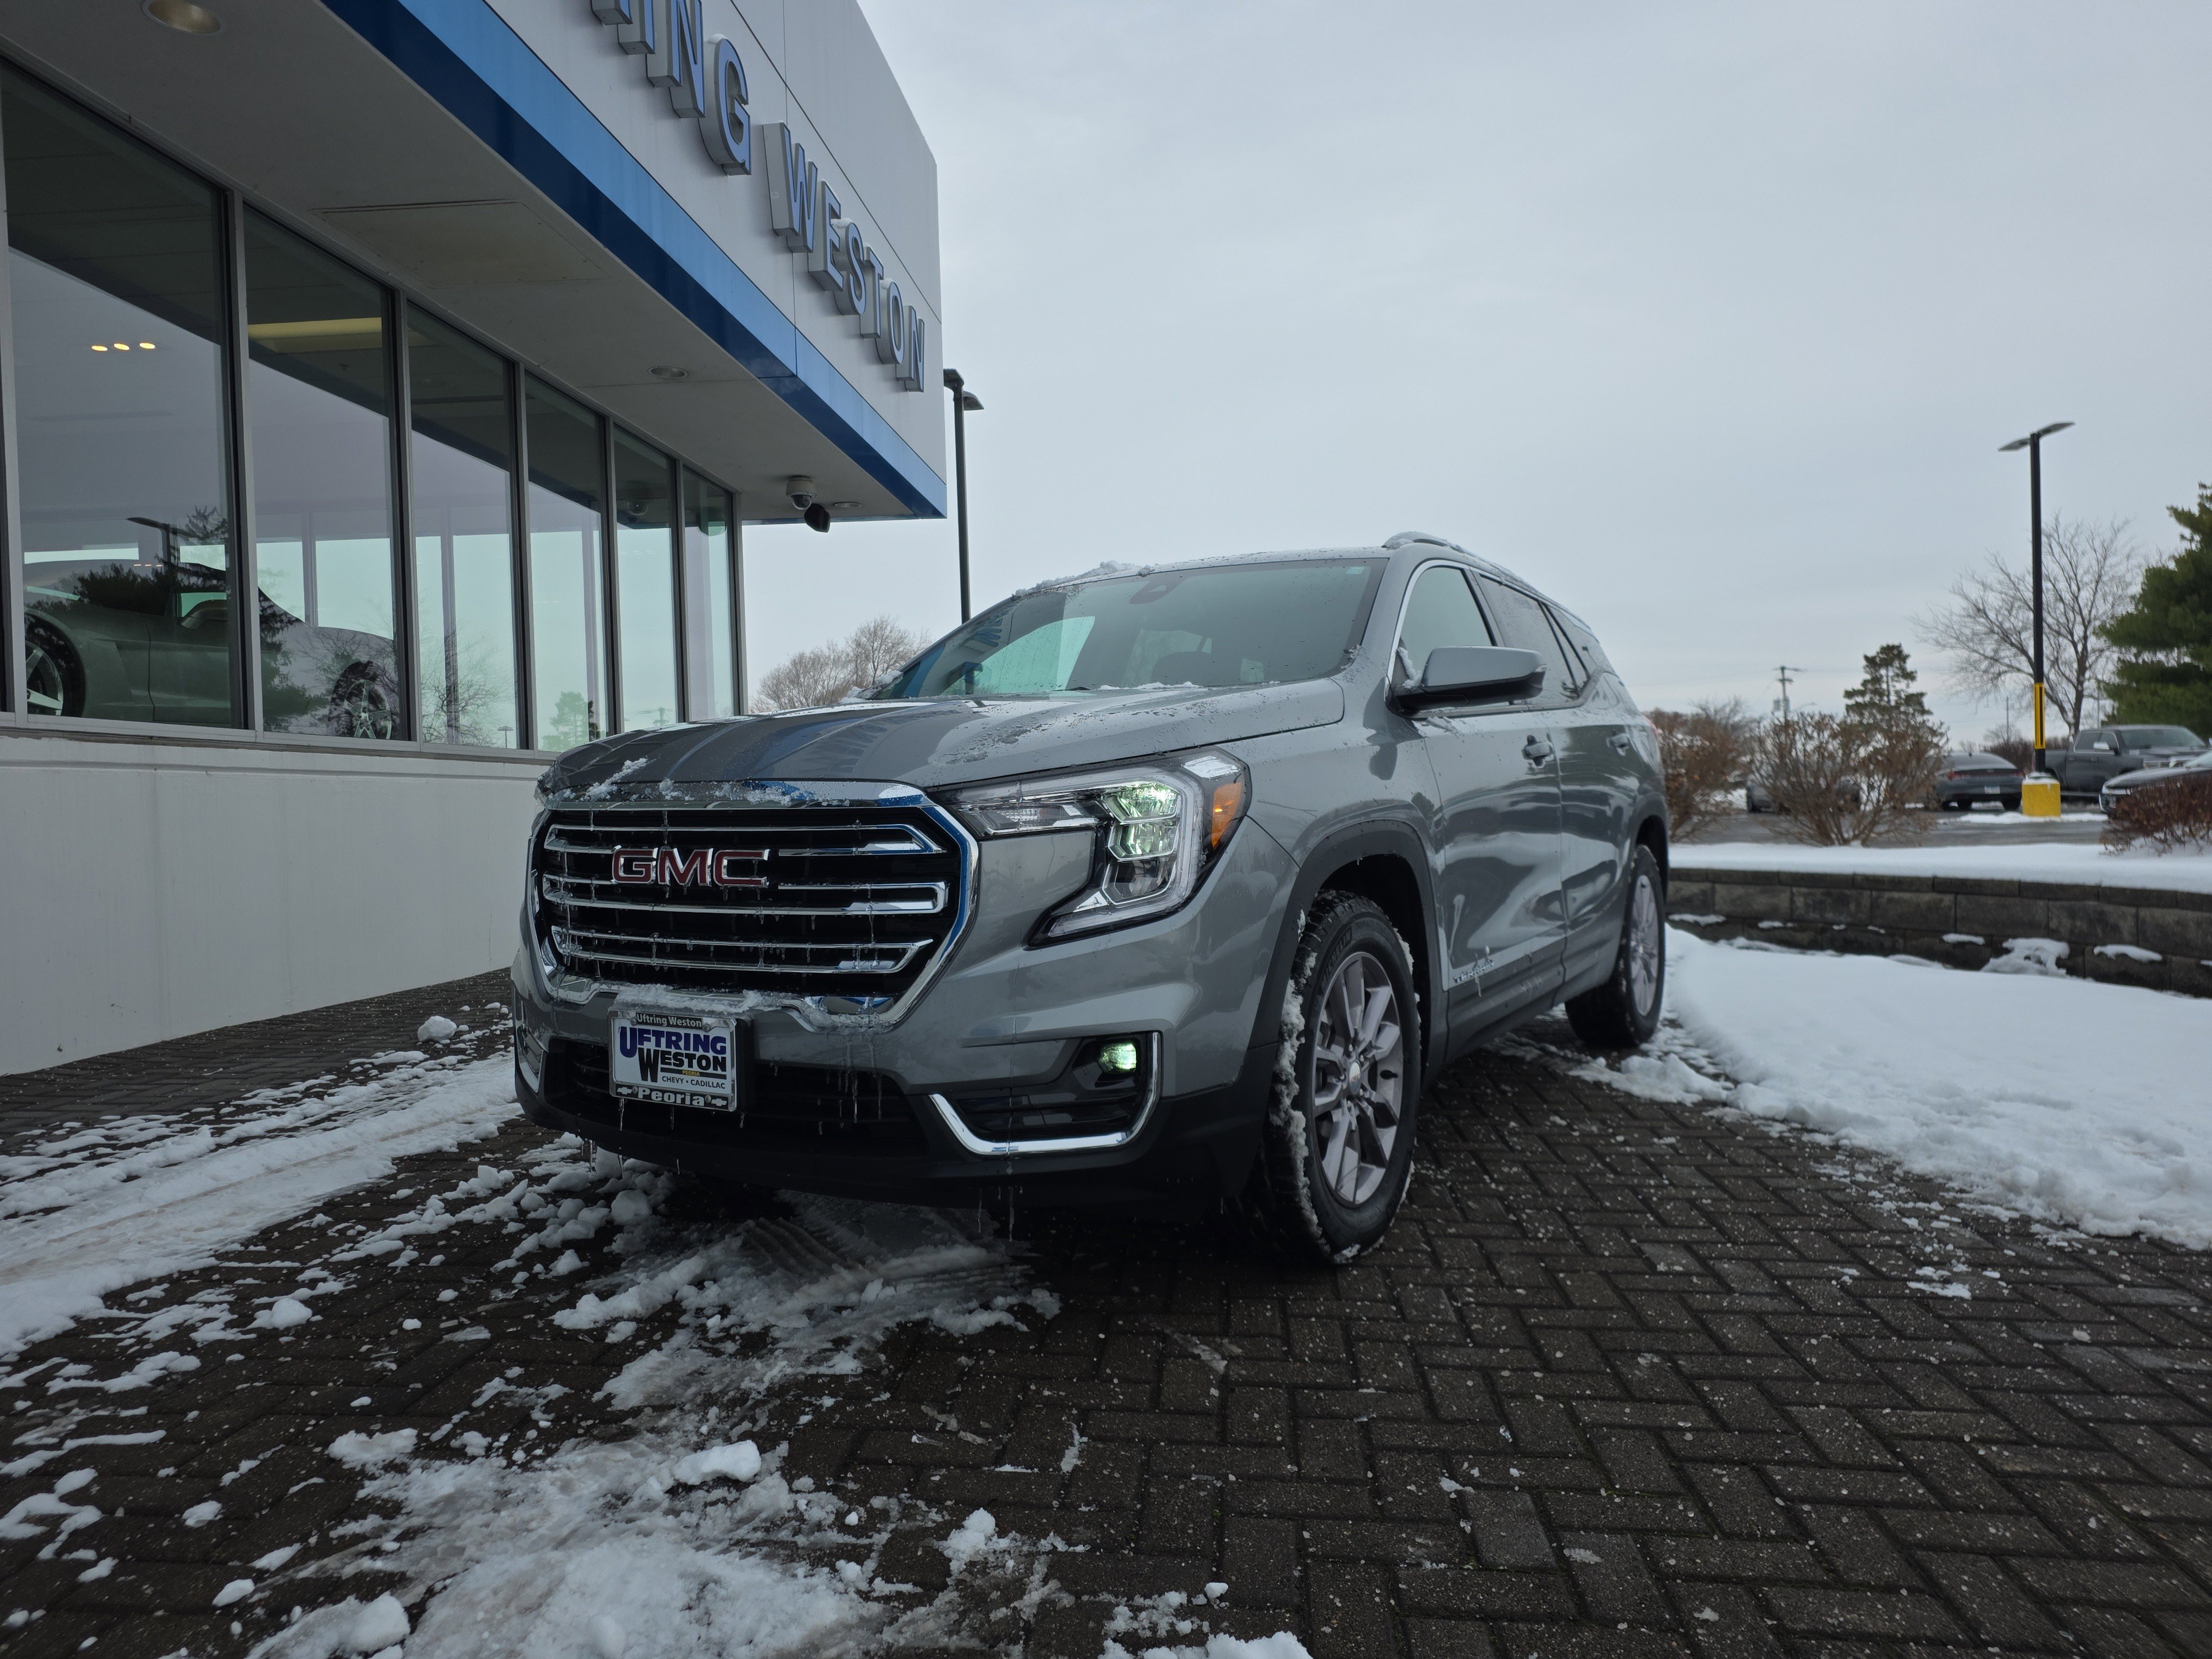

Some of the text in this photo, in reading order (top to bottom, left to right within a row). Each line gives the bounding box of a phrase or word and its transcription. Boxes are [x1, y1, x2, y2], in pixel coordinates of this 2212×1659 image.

[763, 121, 924, 393] WESTON
[613, 847, 769, 887] GMC
[636, 1013, 702, 1027] Uftring Weston
[619, 1026, 726, 1058] UFTRING
[638, 1047, 726, 1083] WESTON
[638, 1086, 704, 1107] Peoria
[662, 1076, 725, 1089] CHEVY CADILLAC
